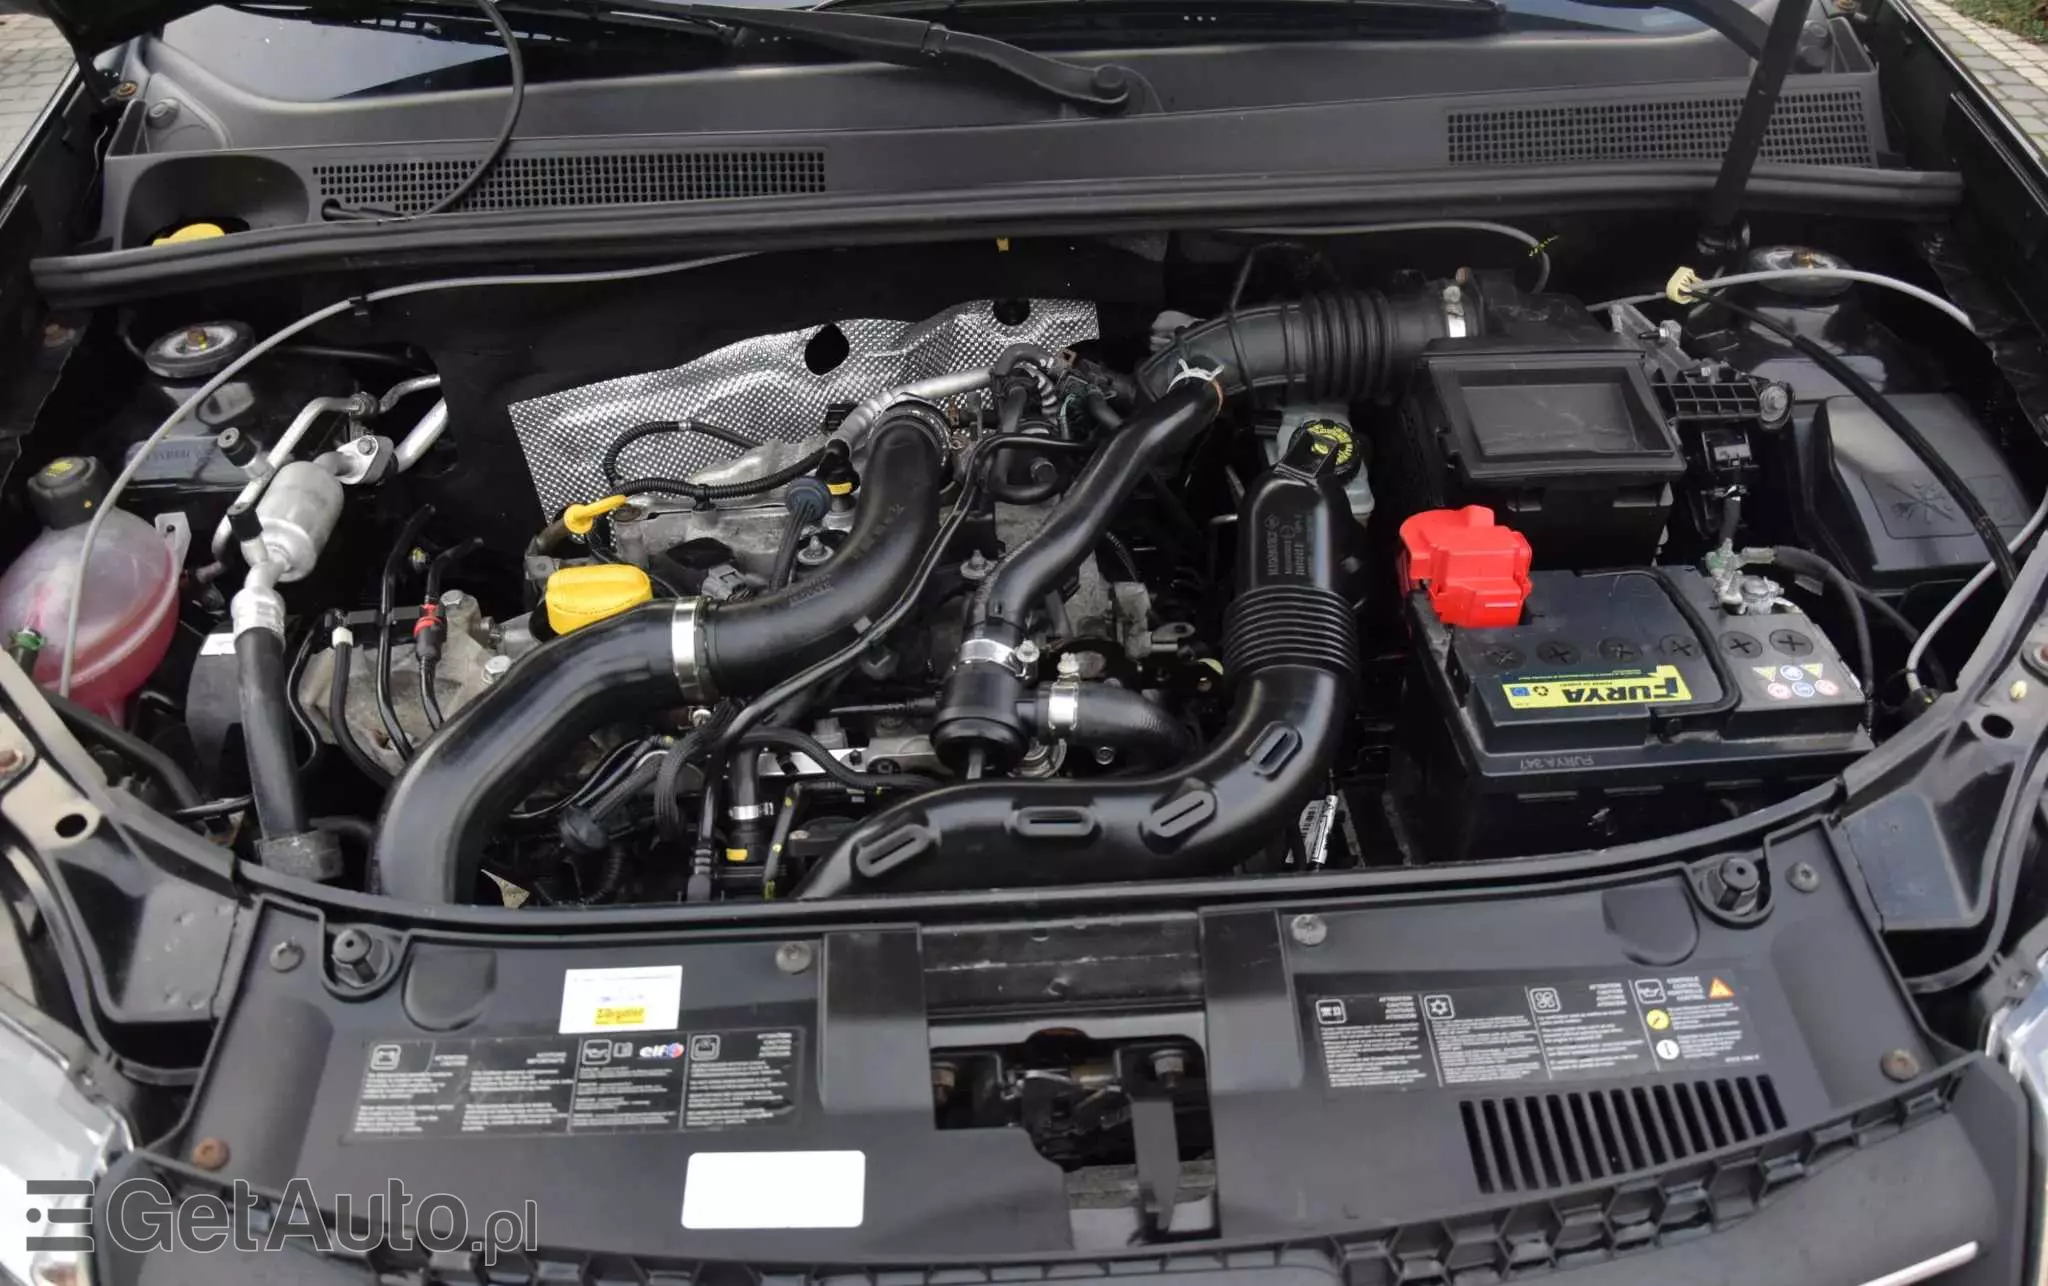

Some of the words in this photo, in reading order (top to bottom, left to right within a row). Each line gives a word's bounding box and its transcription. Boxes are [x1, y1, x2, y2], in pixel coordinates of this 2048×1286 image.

[1562, 677, 1679, 704] FURYA
[1544, 755, 1595, 768] FURYA
[639, 1044, 669, 1058] elf
